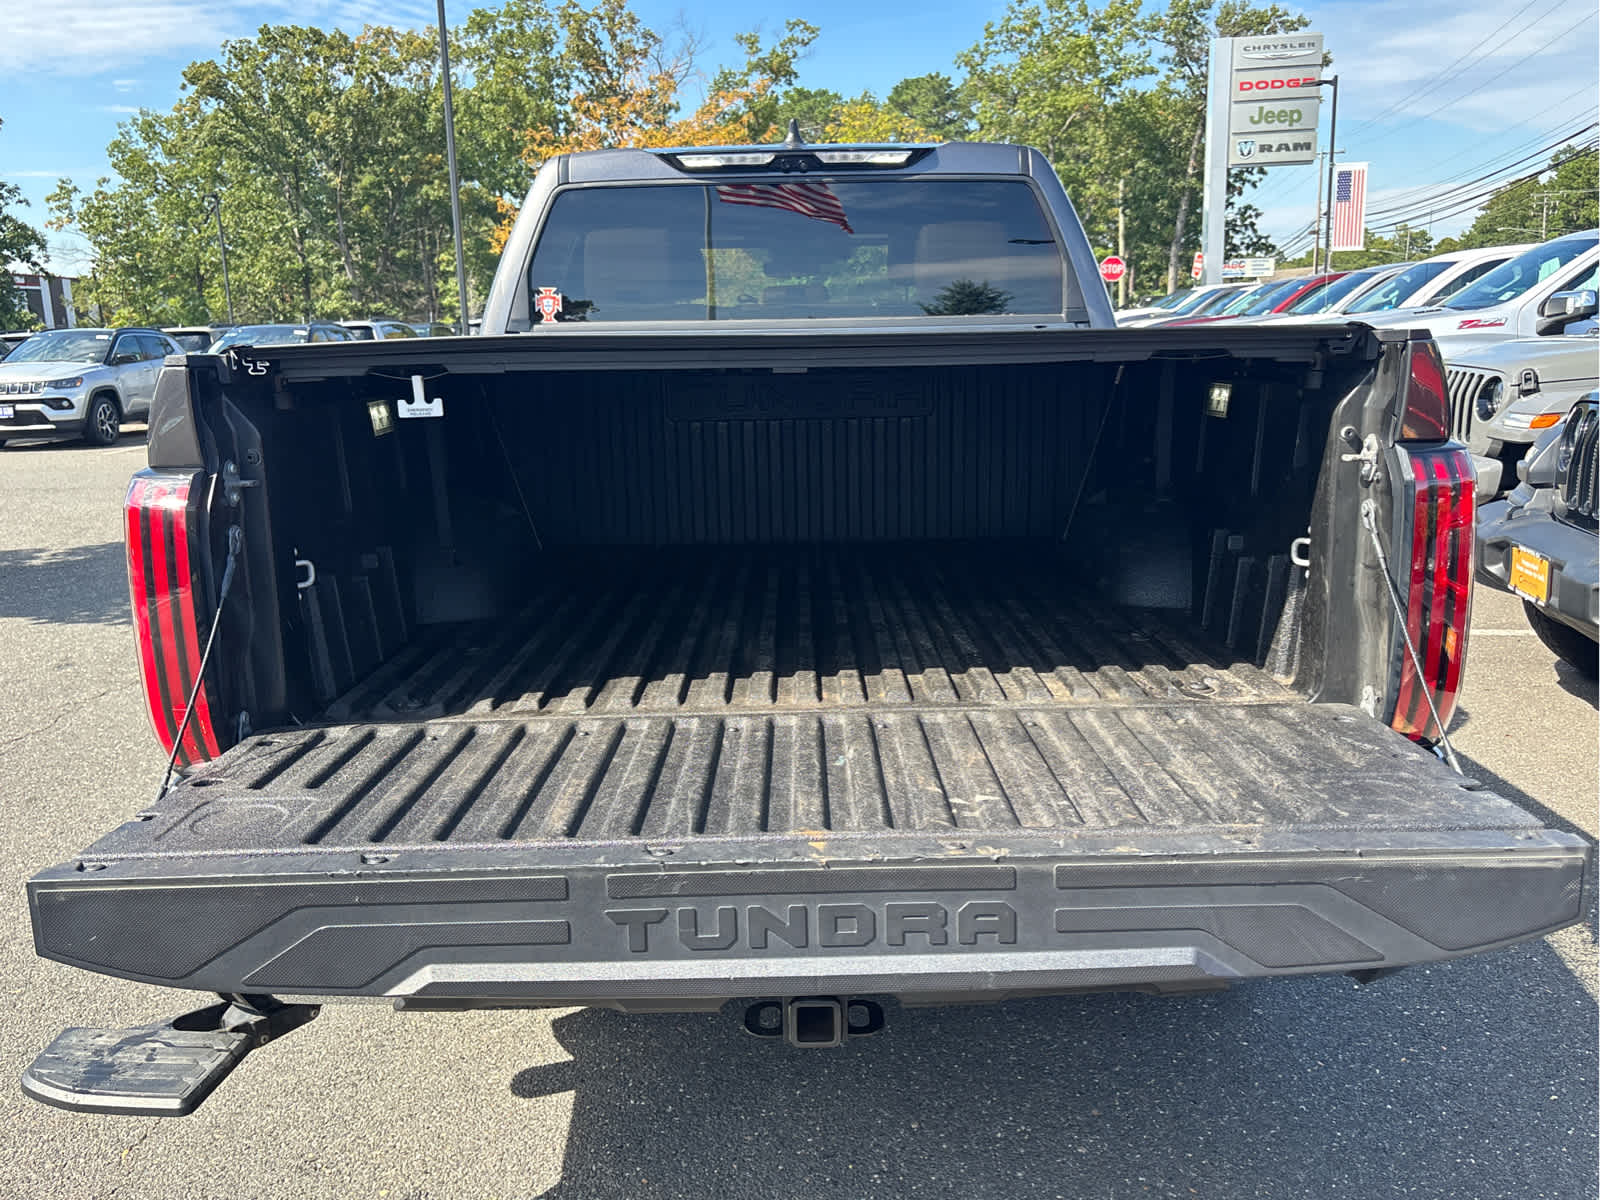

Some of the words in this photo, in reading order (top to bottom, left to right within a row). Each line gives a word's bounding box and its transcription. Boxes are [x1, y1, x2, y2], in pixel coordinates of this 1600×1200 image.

[1243, 41, 1316, 51] CHRYSLER
[1249, 106, 1302, 127] Jeep
[1258, 141, 1312, 153] RAM
[1101, 263, 1123, 274] STOP
[604, 901, 1017, 953] TUNDRA
